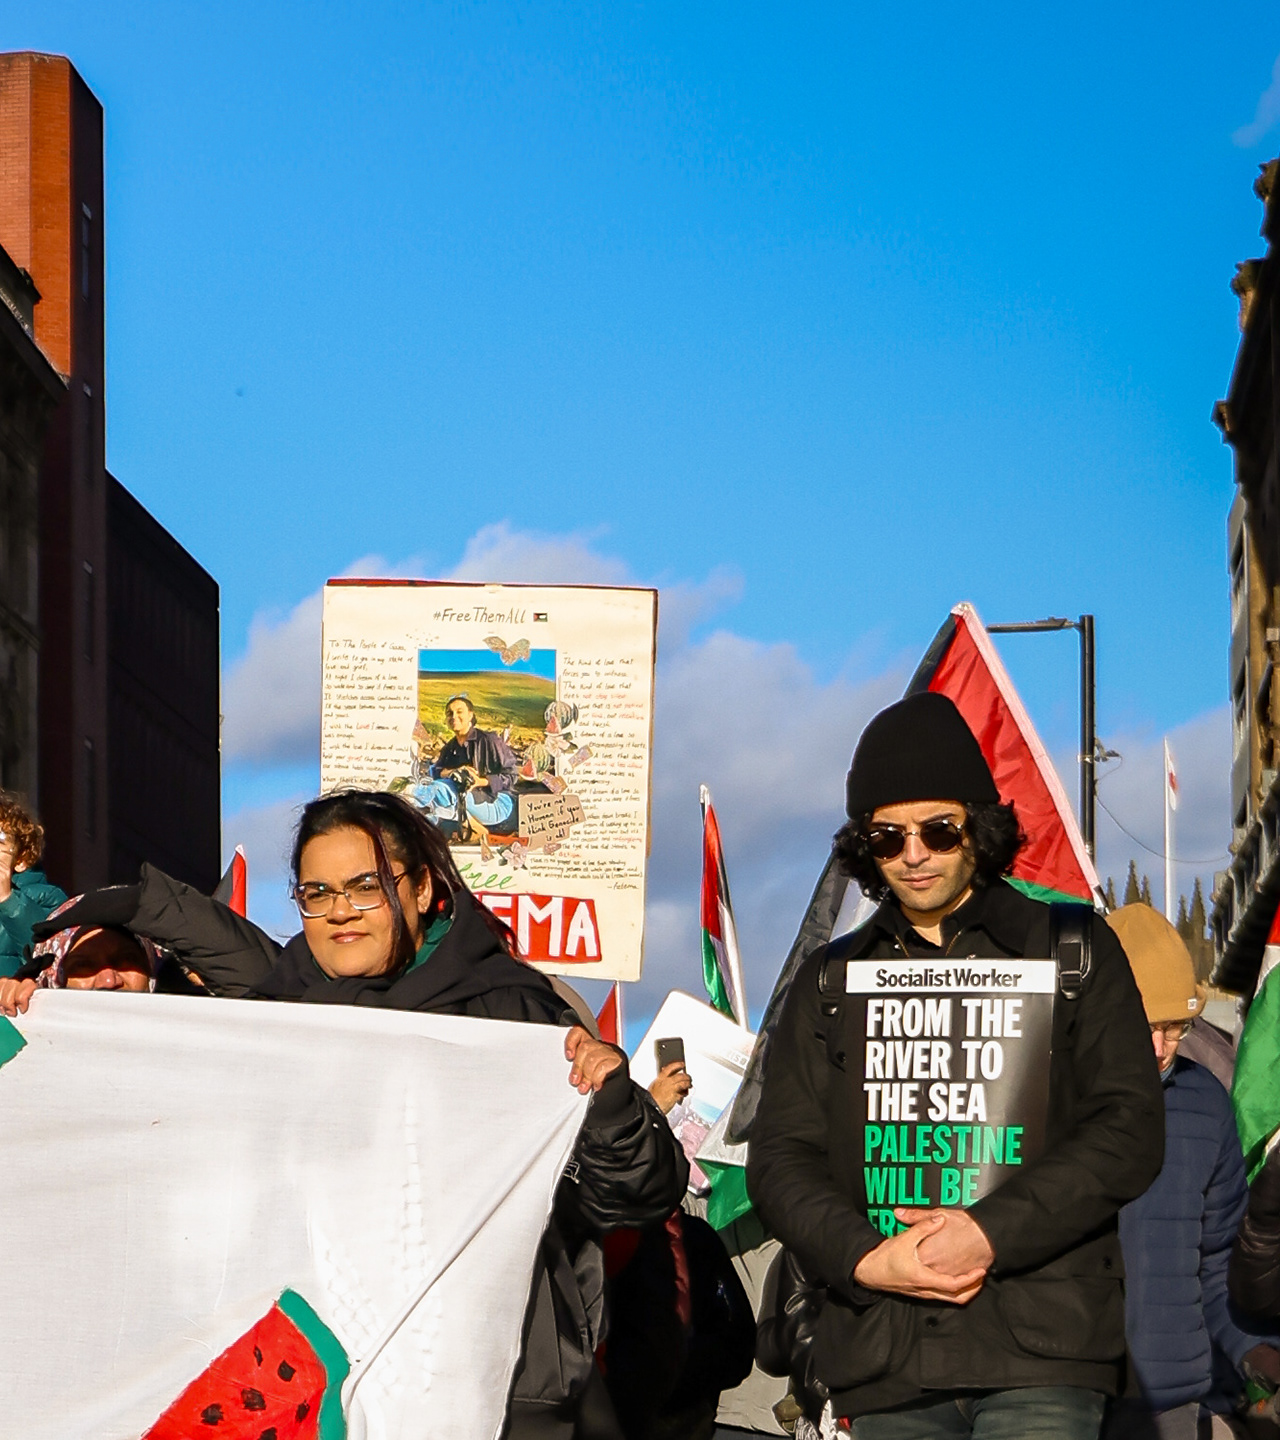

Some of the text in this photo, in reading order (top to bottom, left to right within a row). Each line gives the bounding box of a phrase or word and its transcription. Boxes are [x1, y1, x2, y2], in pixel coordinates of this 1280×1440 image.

[432, 606, 526, 625] #FreeThemAll
[527, 796, 565, 811] You're not
[875, 968, 1022, 988] Socialist Worker
[866, 999, 1023, 1038] FROM THE
[866, 1041, 1004, 1081] RIVER TO
[863, 1083, 987, 1122] THE SEA
[864, 1126, 1024, 1165] PALESTINE
[864, 1167, 978, 1206] WILL BE
